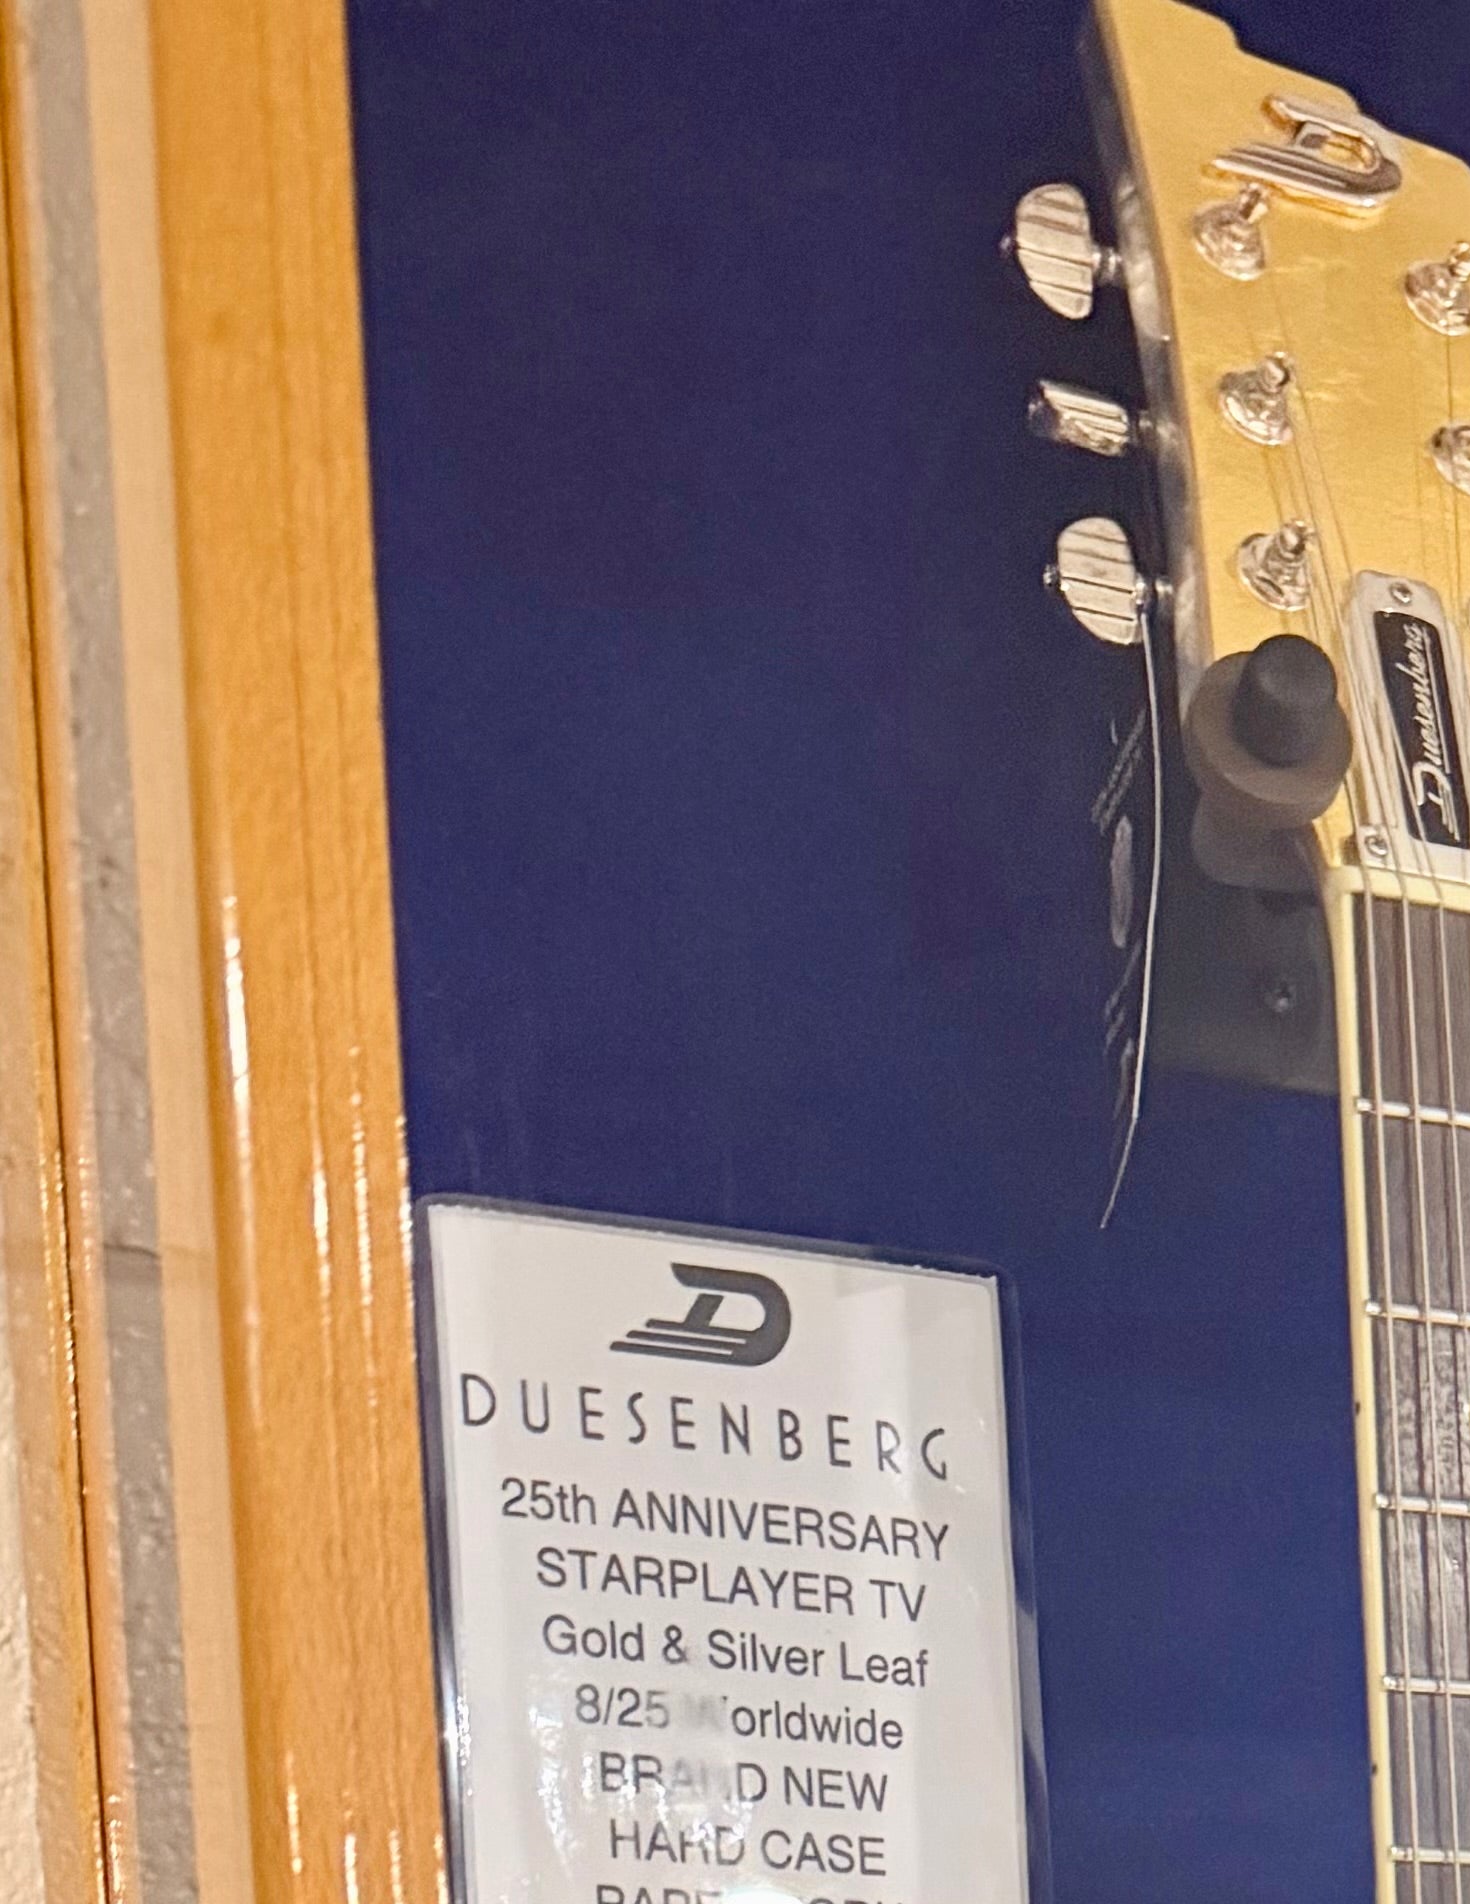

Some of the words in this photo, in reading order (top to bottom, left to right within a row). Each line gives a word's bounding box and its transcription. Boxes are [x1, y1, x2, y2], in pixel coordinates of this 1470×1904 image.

[461, 1374, 949, 1481] DUESENBERG
[501, 1477, 597, 1527] 25th
[613, 1488, 949, 1562] ANNIVERSARY
[536, 1550, 854, 1617] STARPLAYER
[870, 1580, 926, 1623] TV
[542, 1615, 644, 1663] Gold
[663, 1623, 689, 1663] &
[708, 1632, 825, 1680] Silver
[841, 1642, 929, 1688] Leaf
[575, 1684, 669, 1729] 8/25
[682, 1695, 903, 1750] orldwide
[784, 1766, 888, 1813] NEW
[760, 1830, 886, 1876] CASE
